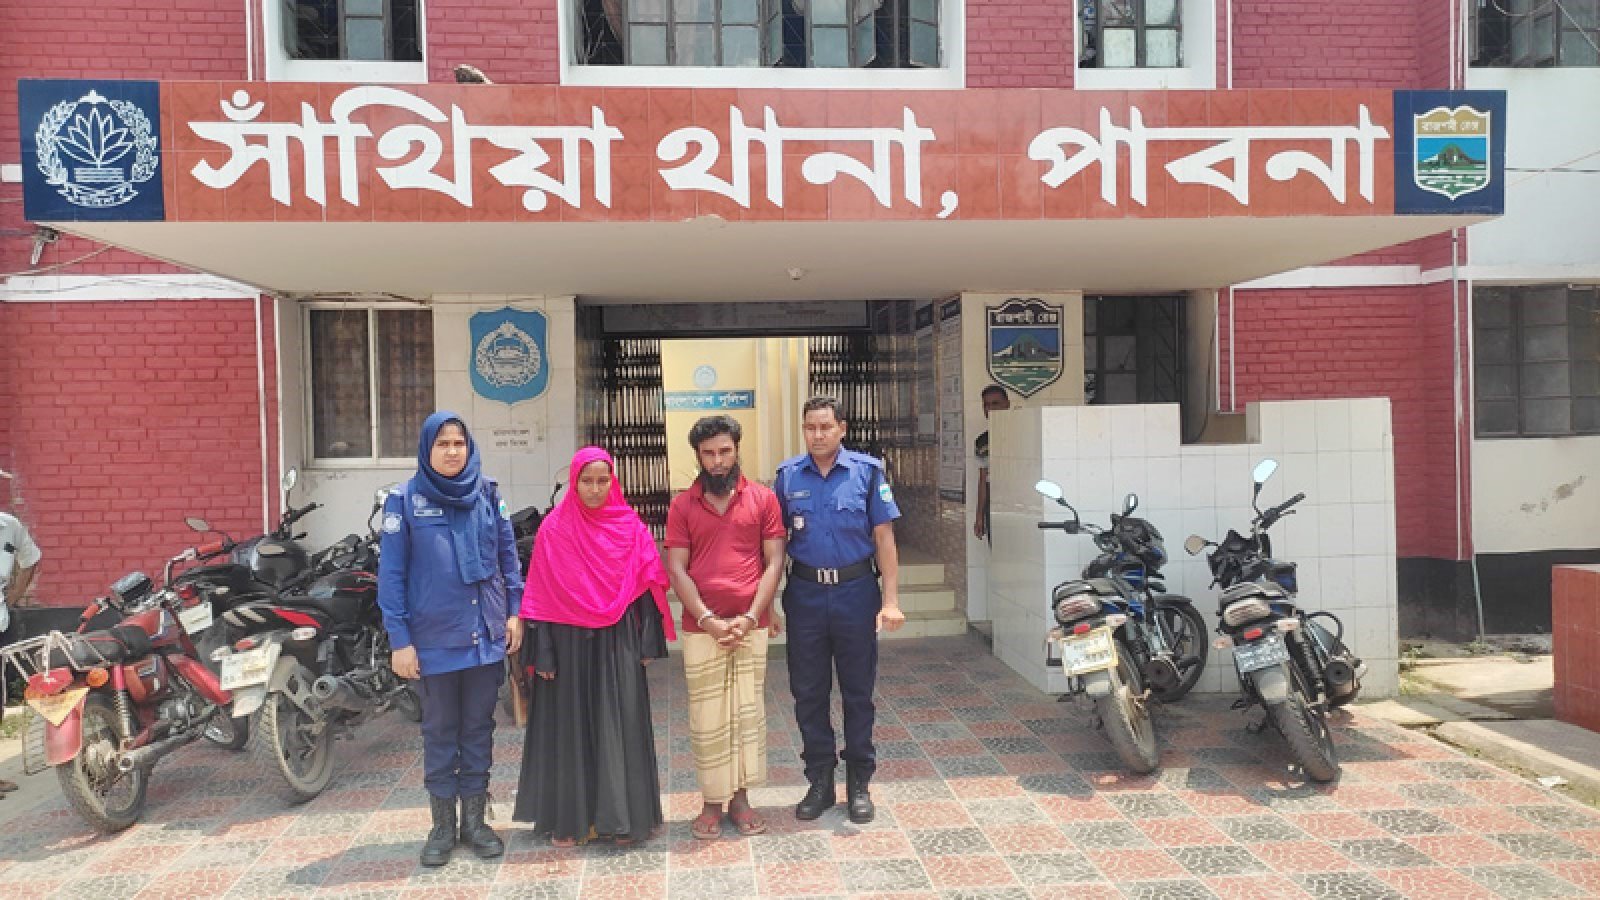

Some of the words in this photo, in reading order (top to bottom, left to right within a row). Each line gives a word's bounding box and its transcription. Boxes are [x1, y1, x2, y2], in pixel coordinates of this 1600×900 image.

[188, 86, 624, 212] সাঁথিয়া
[656, 106, 958, 218] থানা,
[1028, 104, 1390, 206] পাবনা
